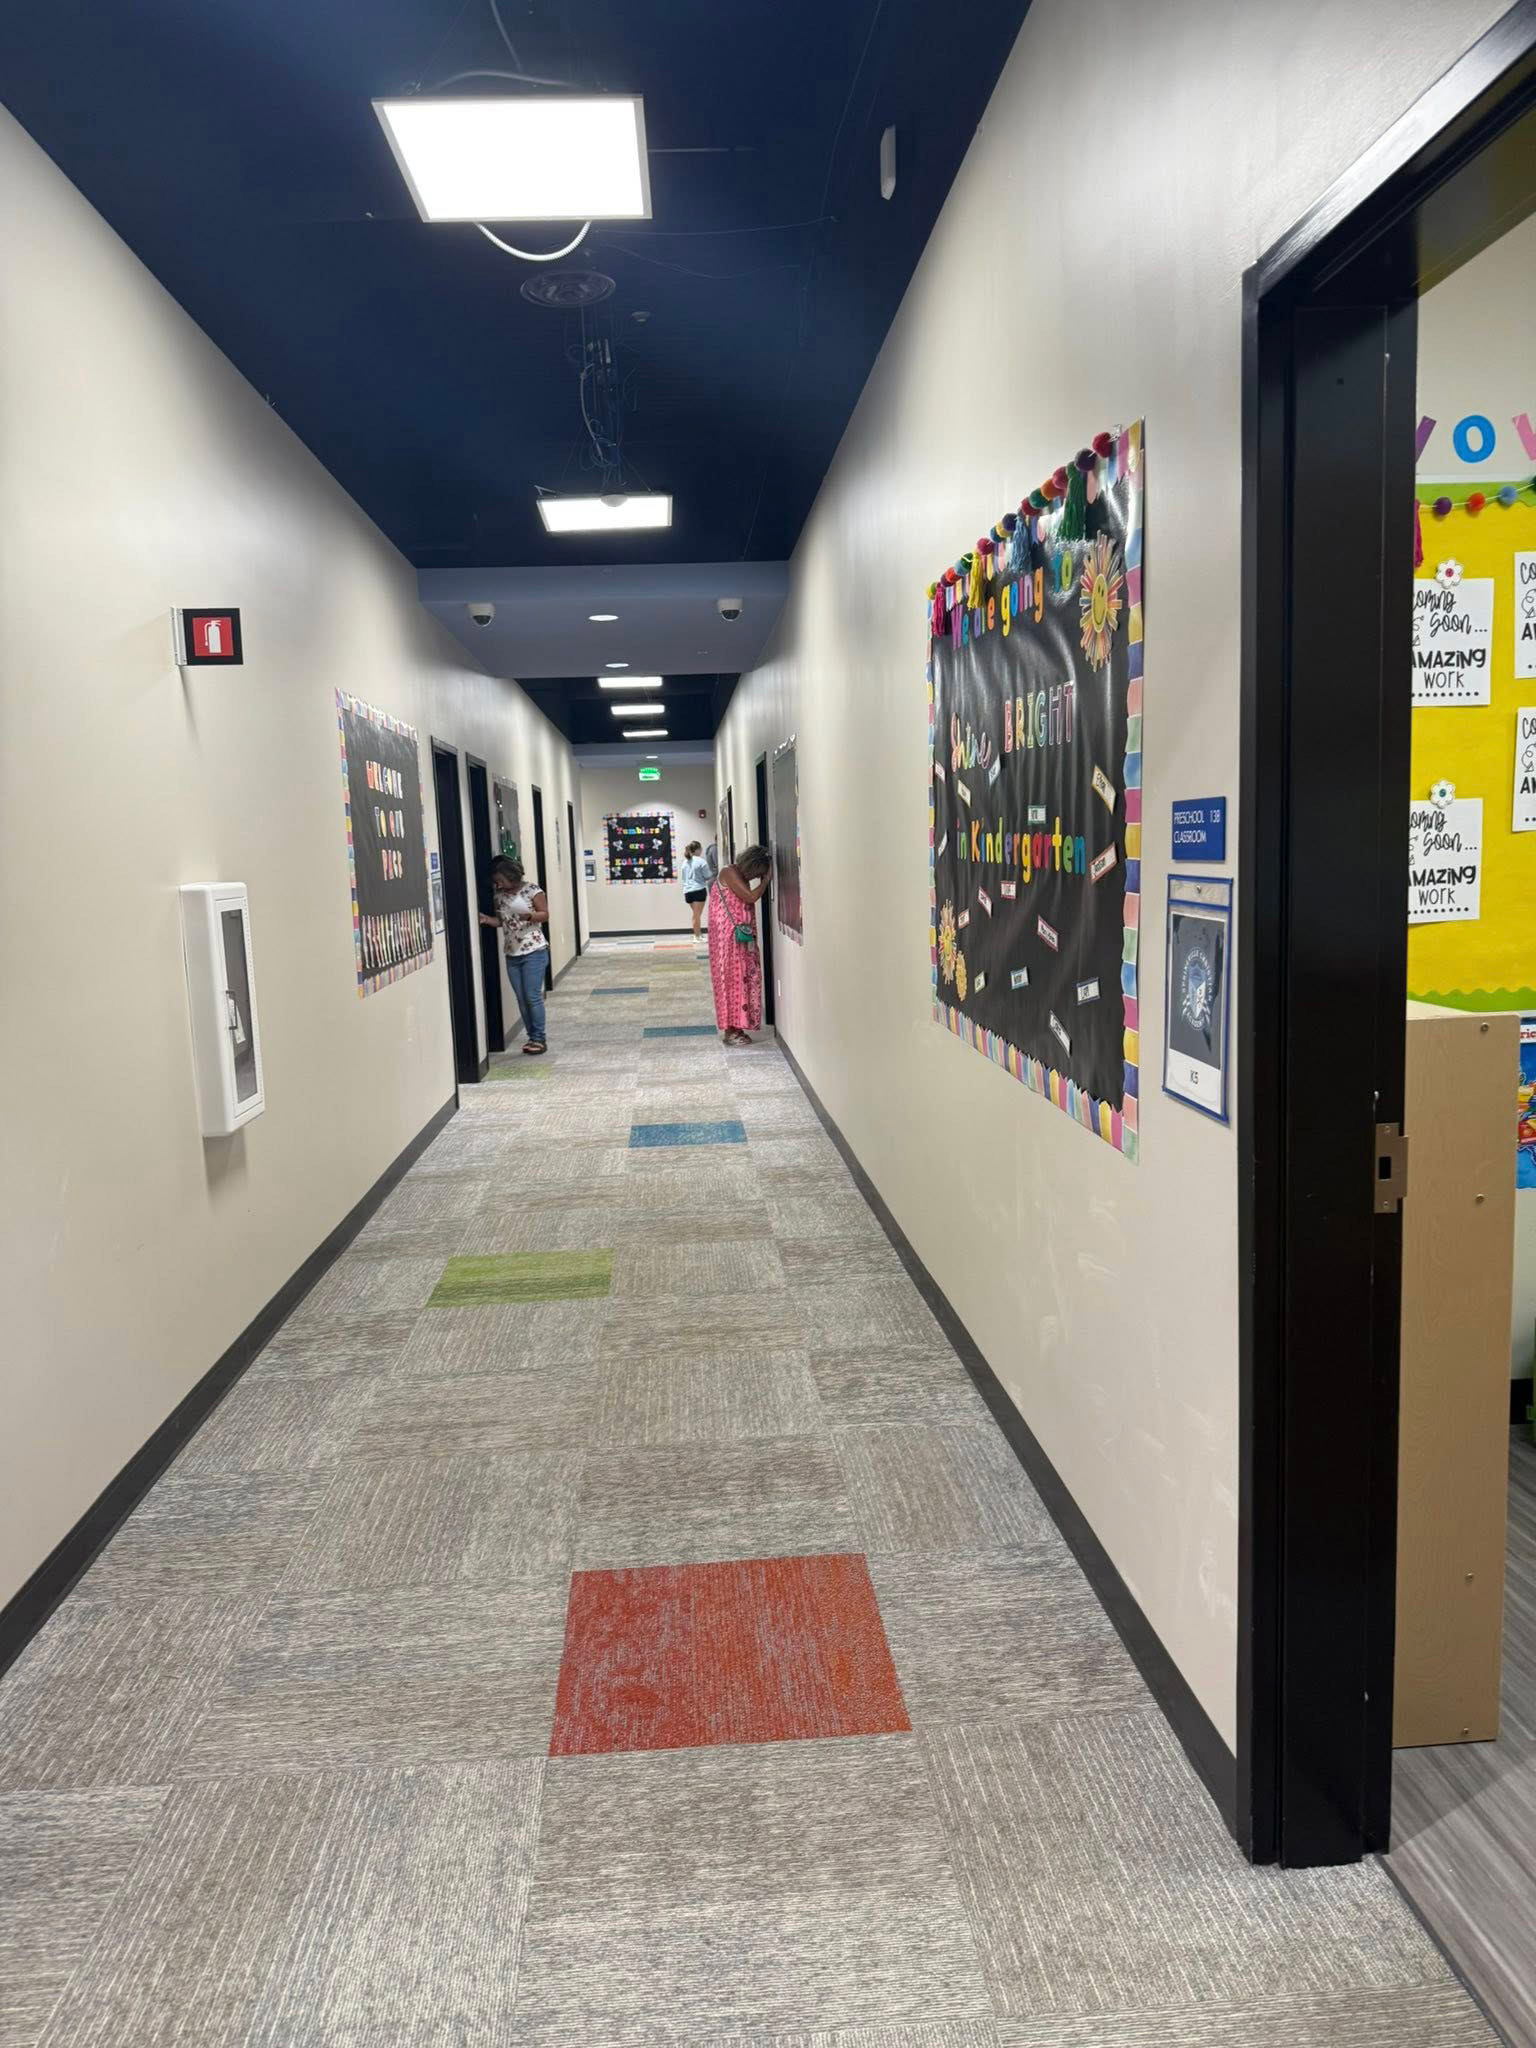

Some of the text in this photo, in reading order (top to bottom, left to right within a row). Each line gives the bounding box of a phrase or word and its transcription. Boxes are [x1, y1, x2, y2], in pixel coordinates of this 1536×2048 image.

[1001, 567, 1044, 636] going
[1004, 681, 1074, 753] BRIGHT
[366, 760, 403, 799] WELCOME
[374, 806, 404, 838] TO OUR
[1174, 810, 1204, 824] PRESCHOOL
[971, 816, 1086, 883] Kindergarten
[1174, 830, 1207, 843] CLASSROOM
[1191, 1069, 1199, 1085] K5
